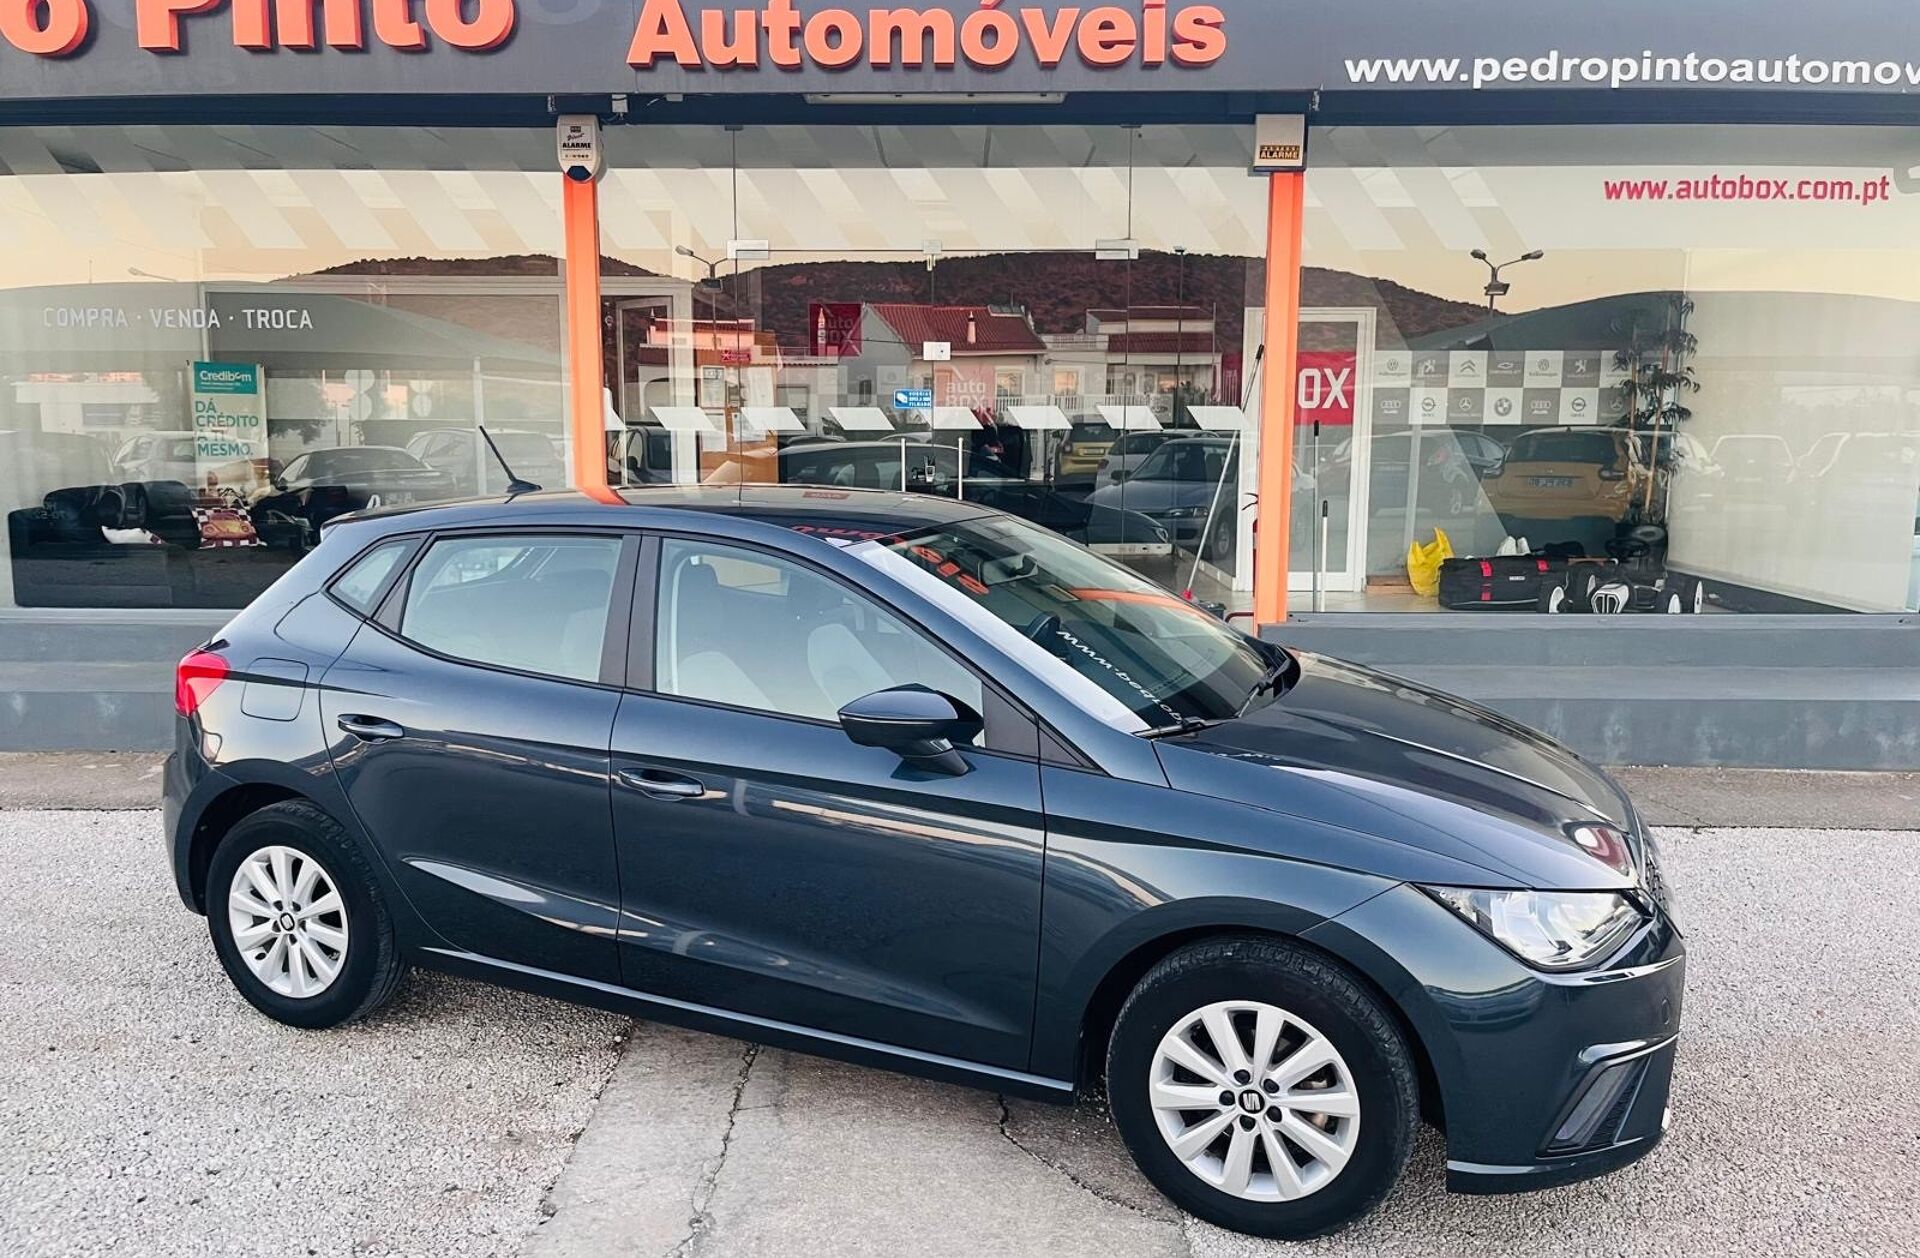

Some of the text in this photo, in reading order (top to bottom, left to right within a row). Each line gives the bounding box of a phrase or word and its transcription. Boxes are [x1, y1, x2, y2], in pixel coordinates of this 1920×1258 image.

[626, 0, 1227, 68] Automóveis
[1260, 151, 1299, 159] ALARME
[1603, 174, 1891, 206] www.autobox.com.pt
[44, 307, 314, 329] COMPRA VENDA TROCA
[200, 370, 252, 382] Credibom
[946, 377, 986, 393] auto
[195, 397, 217, 413] DÁ
[196, 412, 260, 427] CRÉDITO
[197, 443, 254, 457] MESMO.
